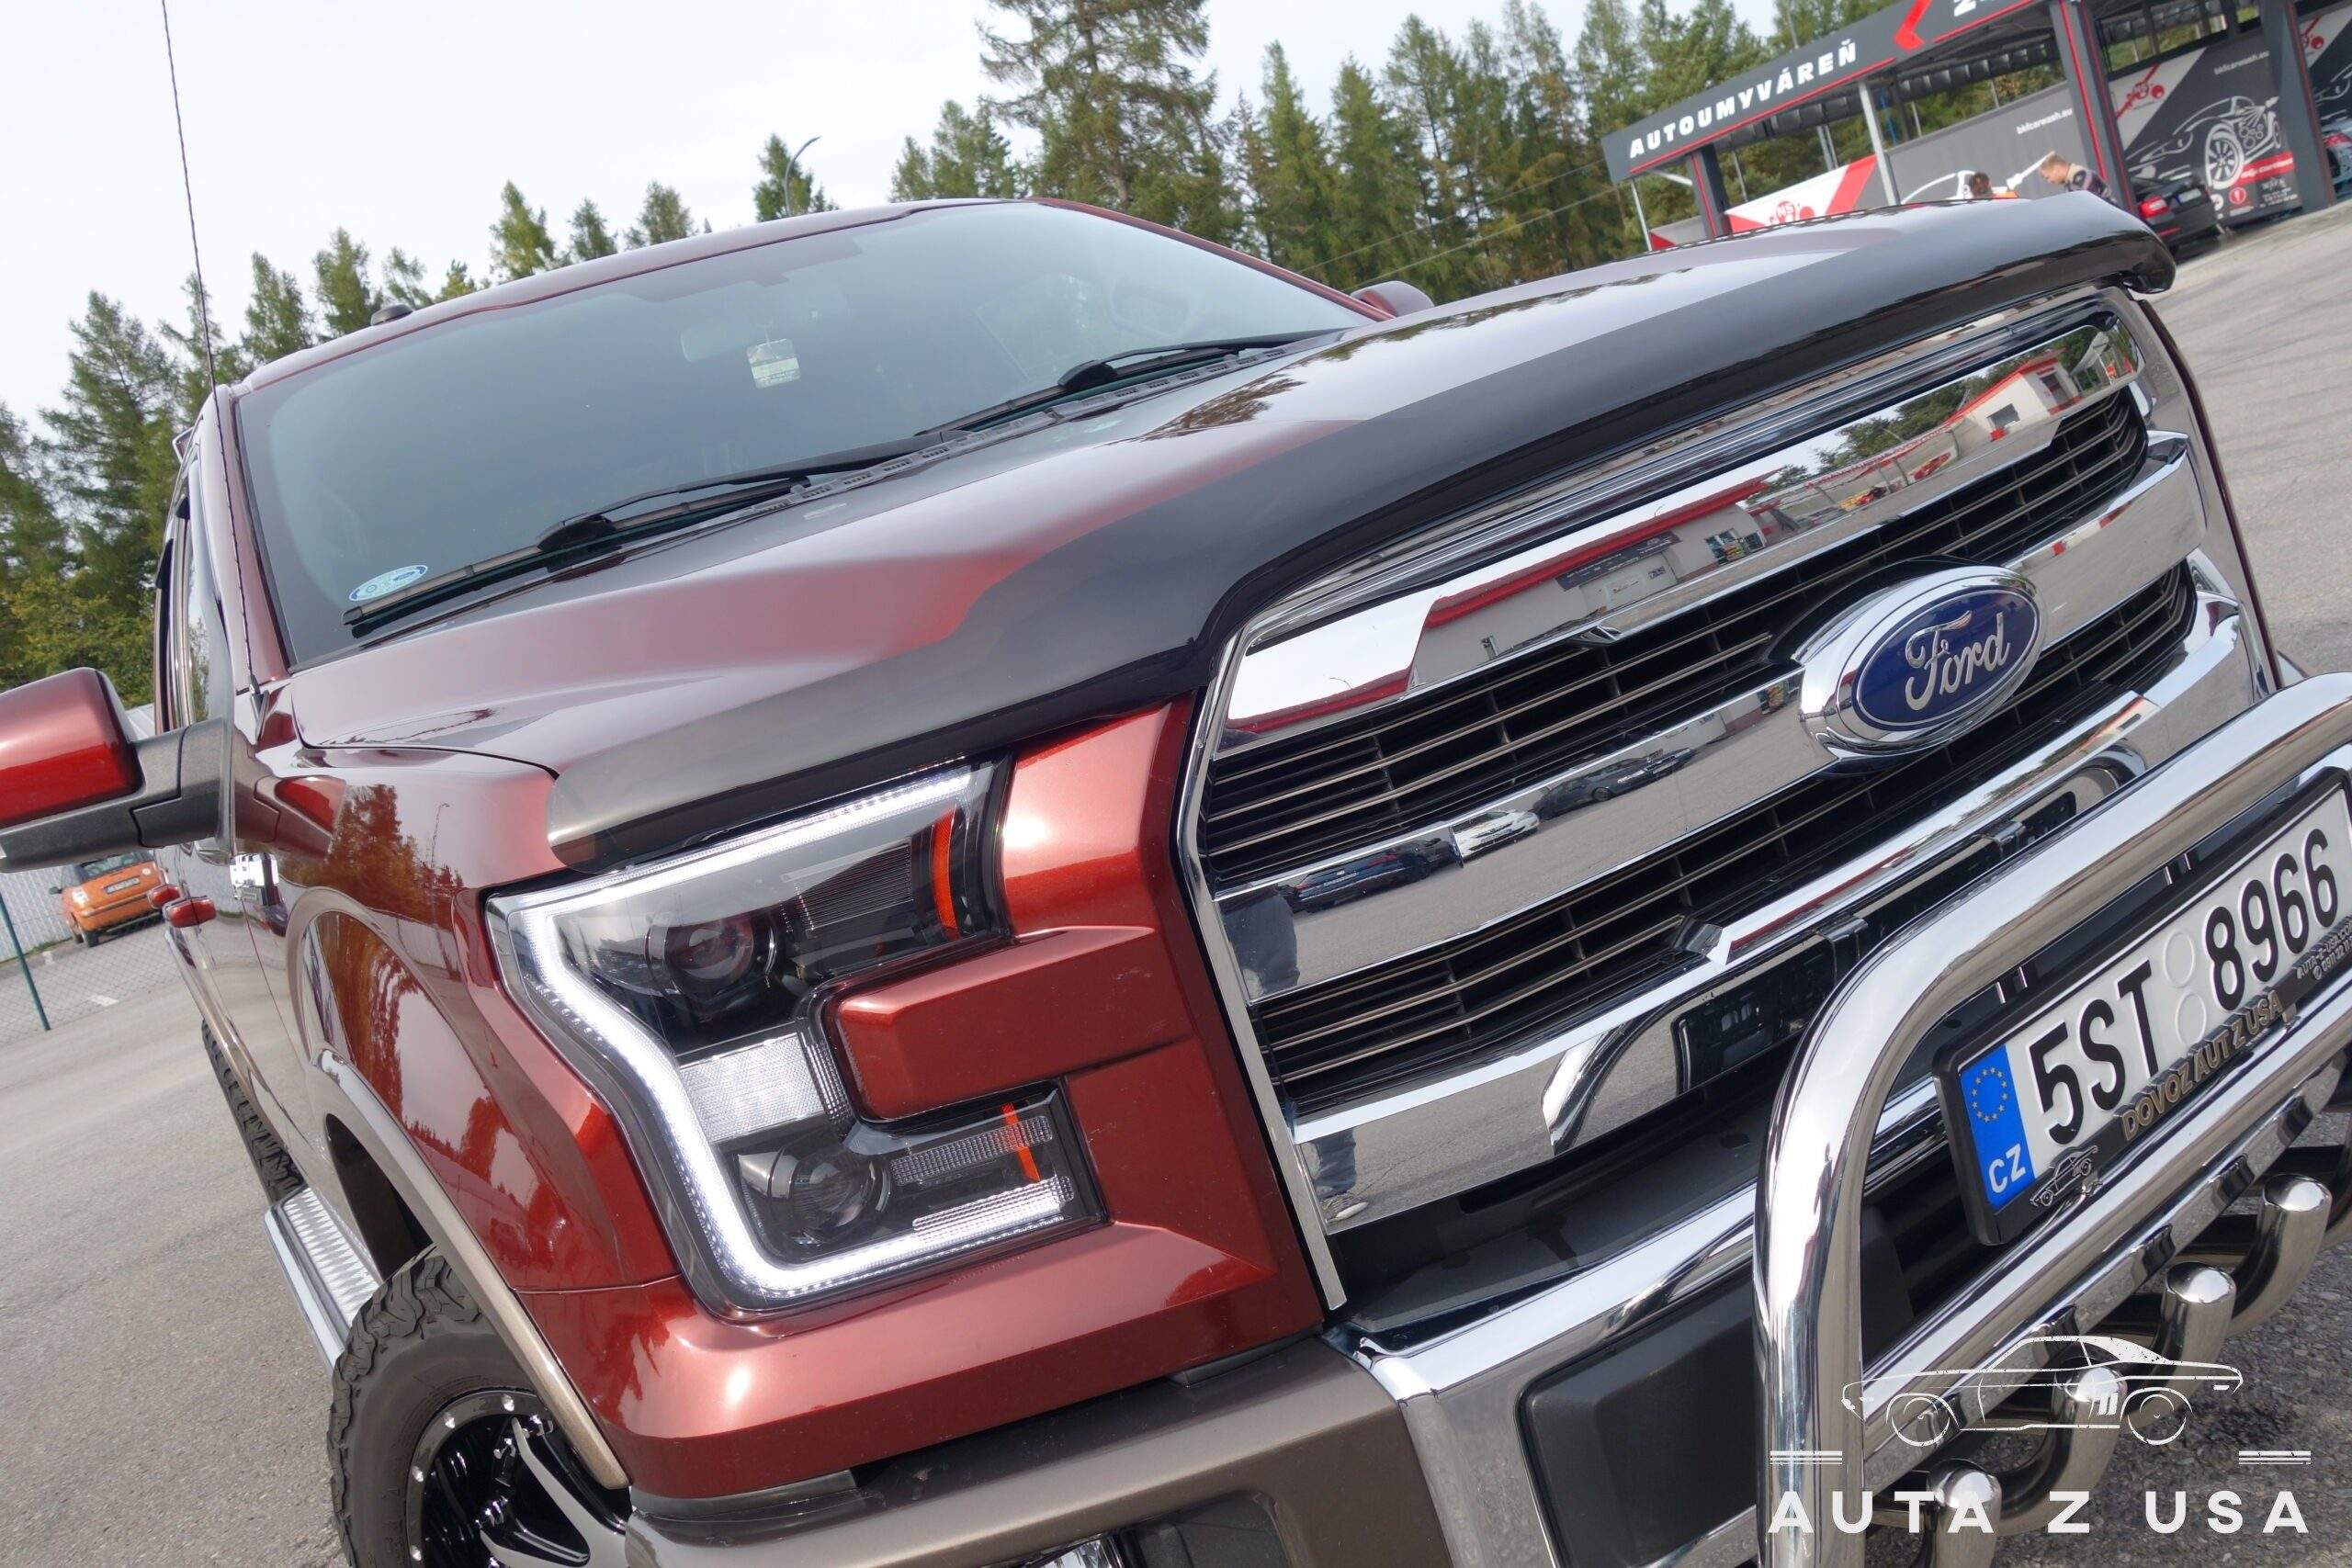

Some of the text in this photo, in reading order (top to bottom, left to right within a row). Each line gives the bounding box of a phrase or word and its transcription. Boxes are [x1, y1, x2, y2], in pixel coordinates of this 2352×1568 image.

[1630, 39, 1857, 159] AUTOUMYVÁREŇ
[1905, 610, 2011, 711] Ford
[2028, 829, 2338, 1145] 5ST 8966
[2121, 989, 2284, 1142] DOVOZ AUT Z USA
[1988, 1143, 2026, 1193] CZ
